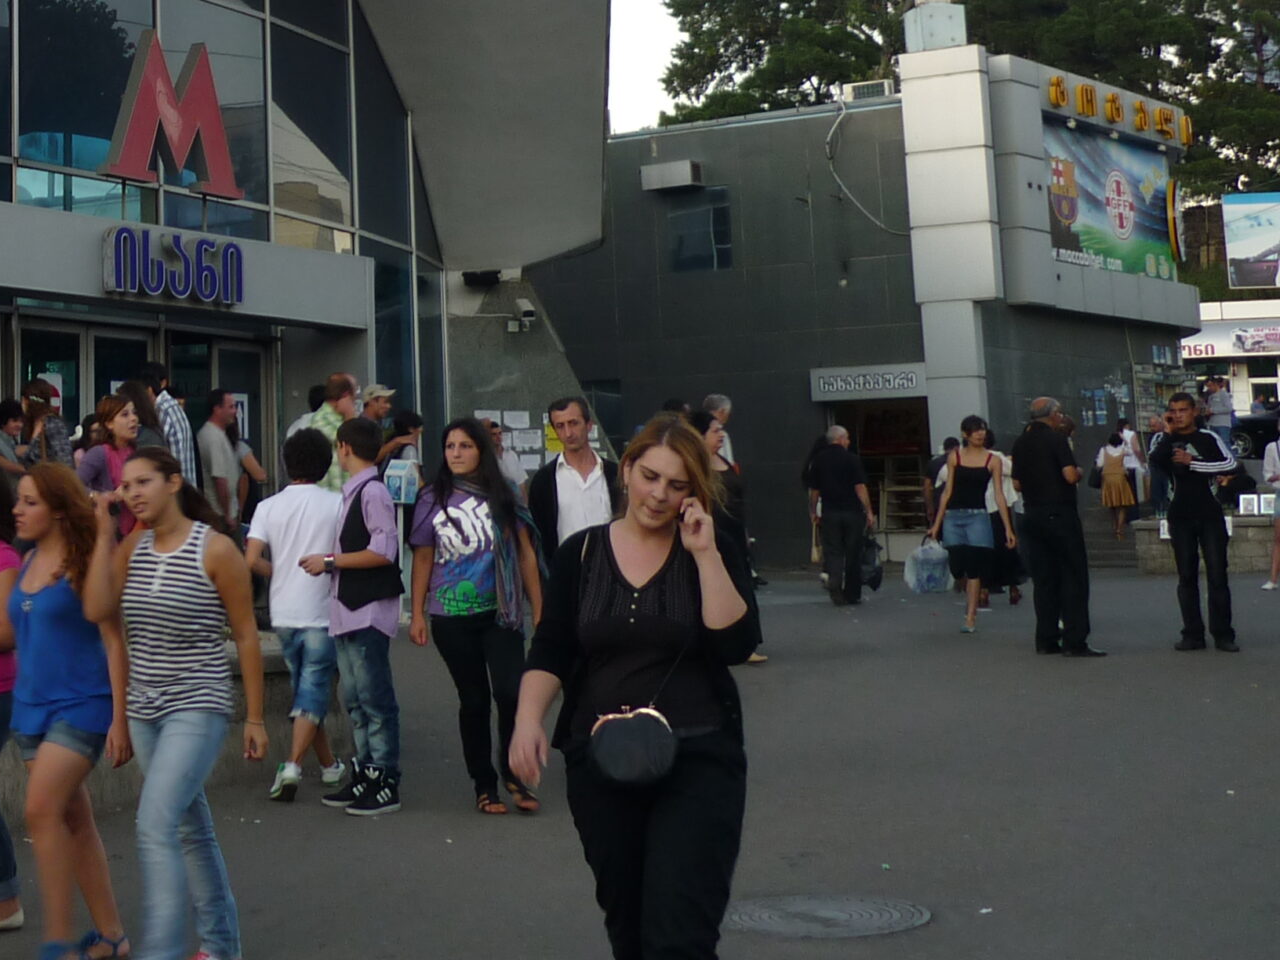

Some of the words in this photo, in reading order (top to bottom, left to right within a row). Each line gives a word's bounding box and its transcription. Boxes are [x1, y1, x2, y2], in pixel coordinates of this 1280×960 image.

[100, 29, 245, 200] M
[1049, 75, 1193, 146] ტოტალი
[112, 226, 244, 304] ისანი
